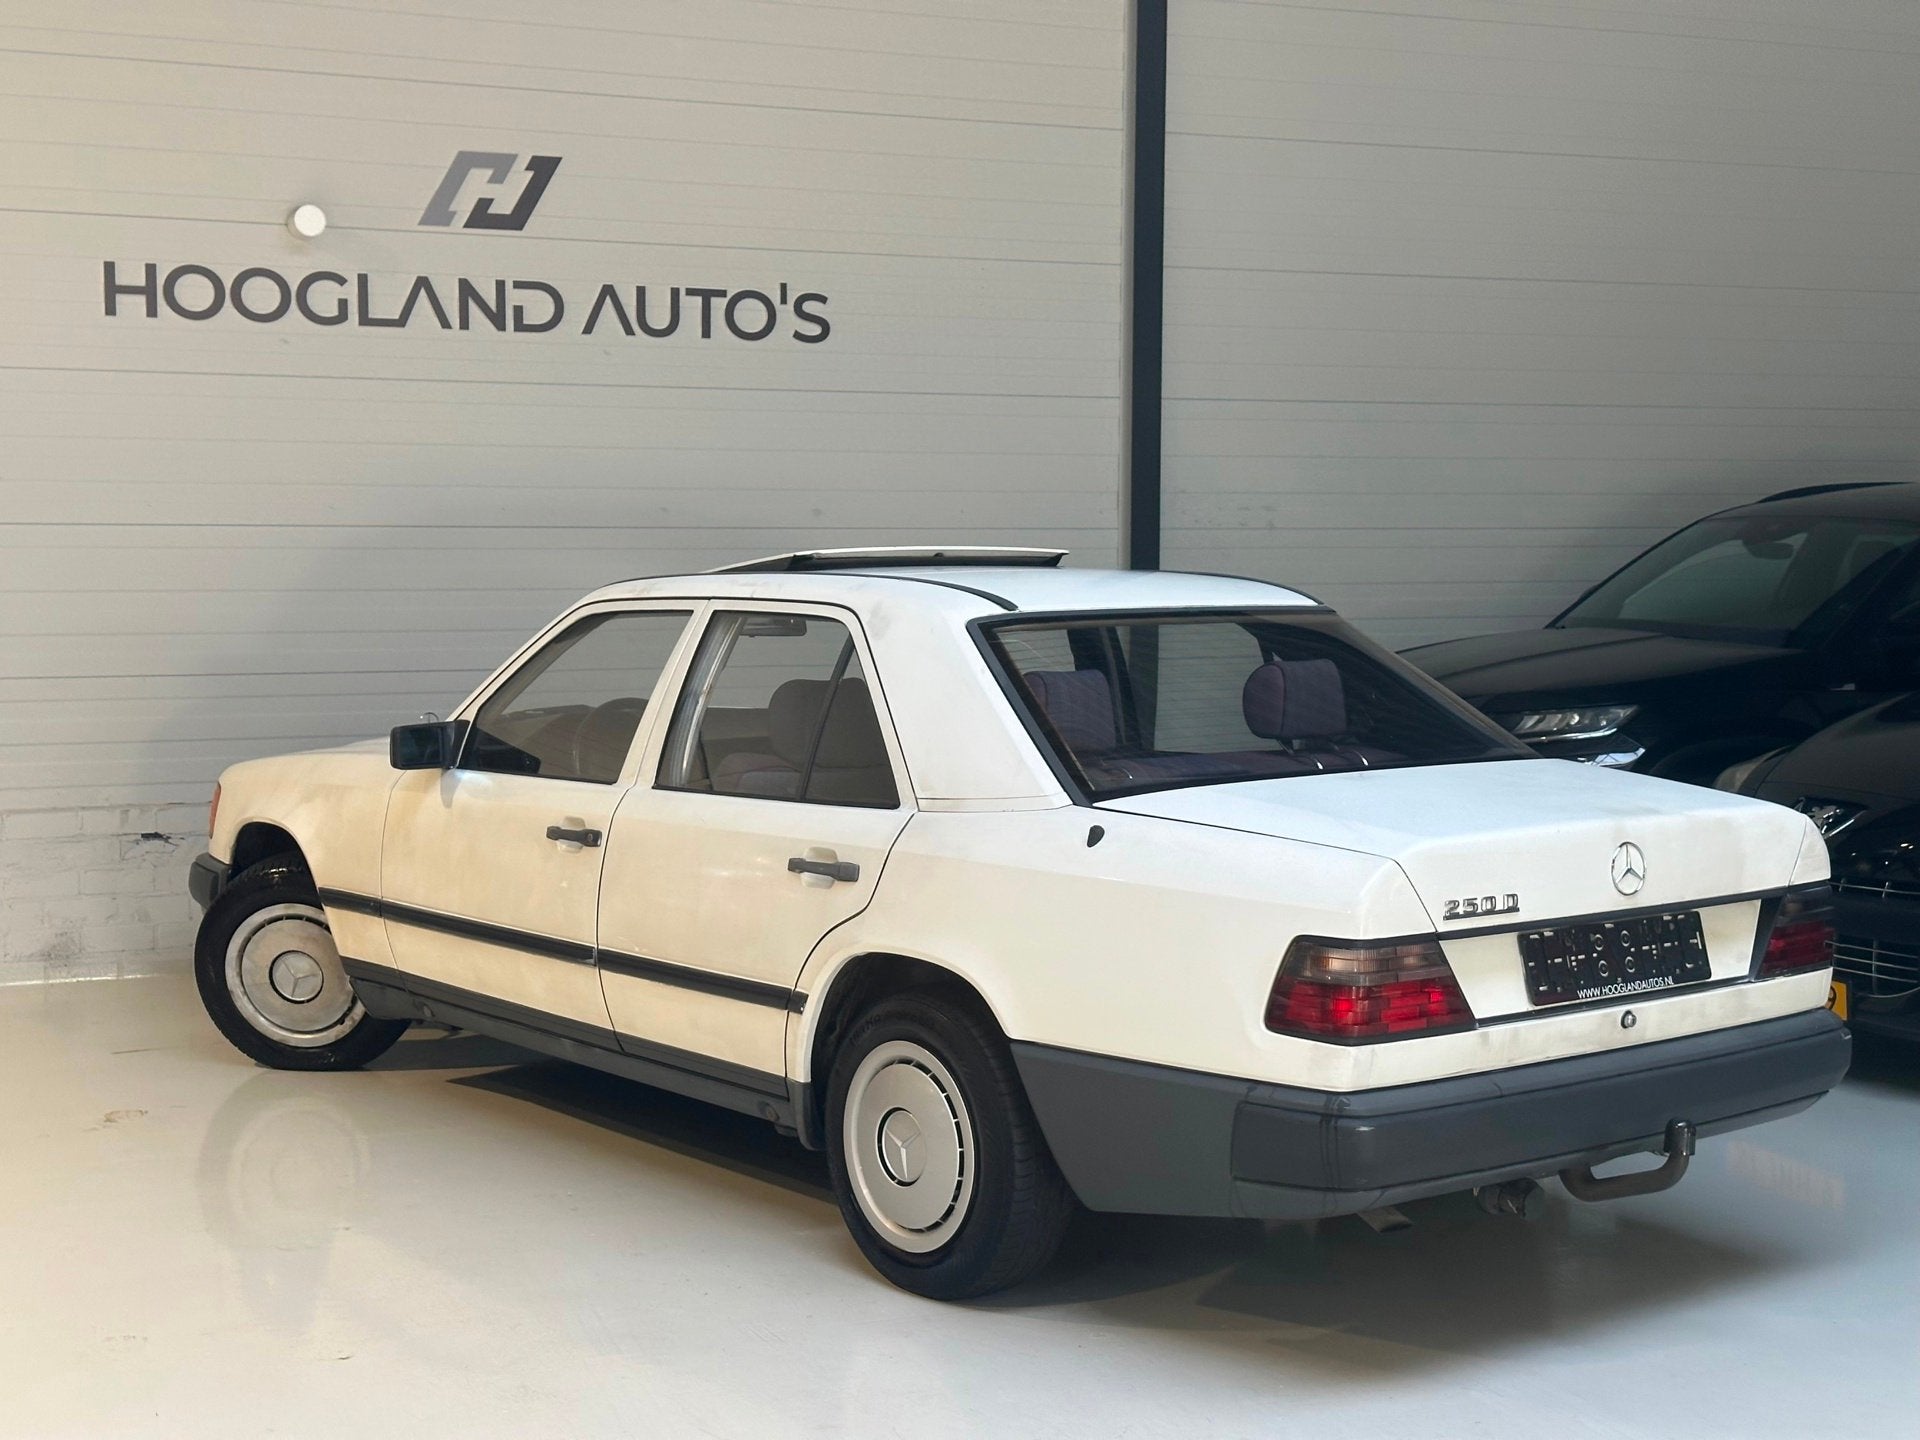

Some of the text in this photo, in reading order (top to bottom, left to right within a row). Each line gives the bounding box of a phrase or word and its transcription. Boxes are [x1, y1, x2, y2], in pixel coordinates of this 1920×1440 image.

[103, 260, 831, 344] HOOGLAND AUTO'S
[1443, 893, 1519, 919] 250 D
[1577, 975, 1675, 999] WWW.HOOGLANDAUTOS.NL
